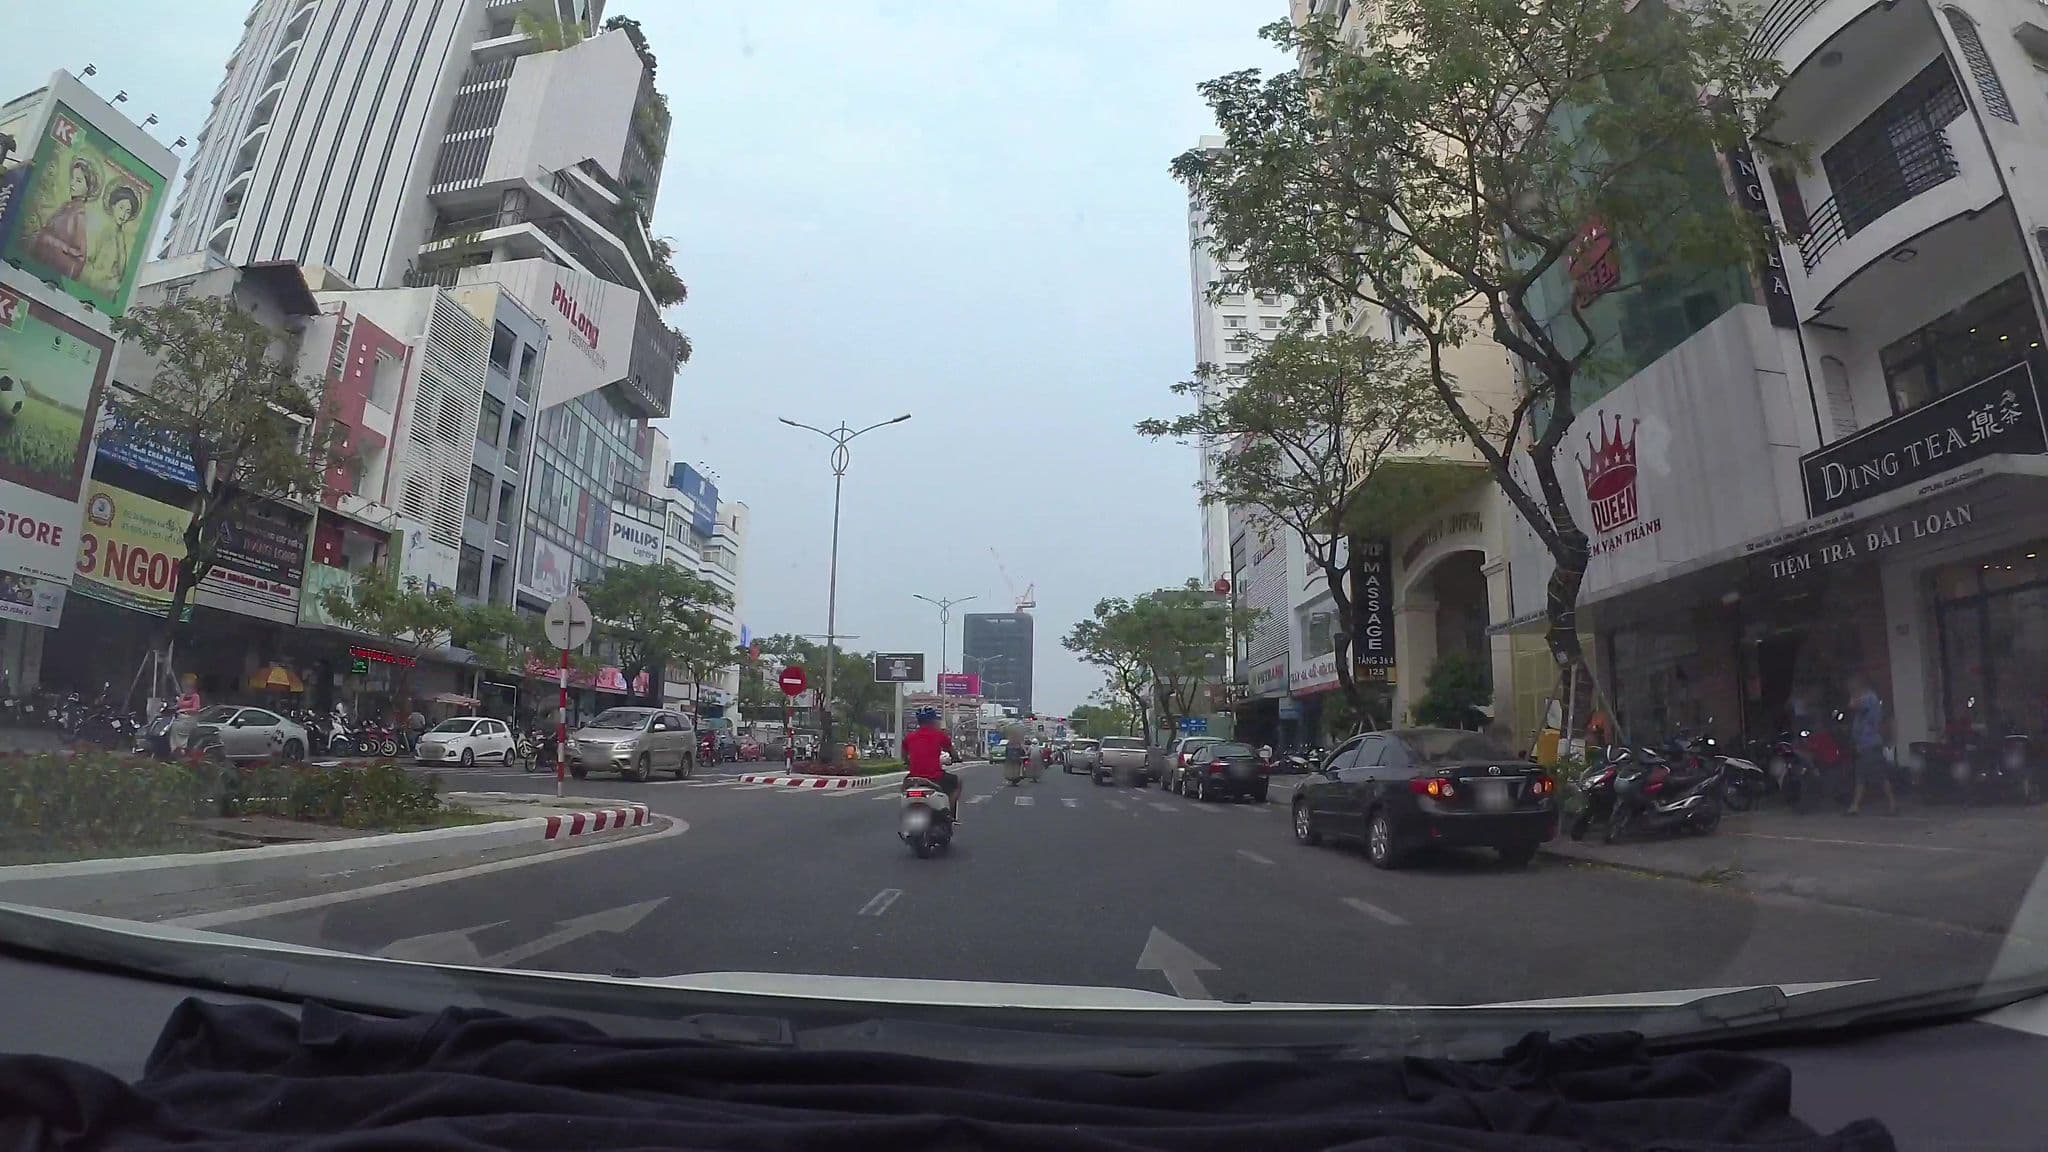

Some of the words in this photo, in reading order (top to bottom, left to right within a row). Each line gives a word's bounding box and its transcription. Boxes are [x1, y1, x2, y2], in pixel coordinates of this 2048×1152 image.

[551, 281, 600, 350] PhiLong
[1821, 451, 1899, 502] DING
[1904, 427, 1967, 469] TEA
[613, 522, 659, 550] PHILIPS
[1591, 484, 1638, 535] QUEEN
[1625, 518, 1662, 543] THÀNH
[77, 533, 98, 574] 3
[1771, 553, 1811, 580] TIỆM
[1819, 537, 1856, 565] TRÀ
[1867, 525, 1902, 552] ĐÀI
[1912, 504, 1974, 539] LOAN
[1363, 561, 1383, 650] MASSAGE
